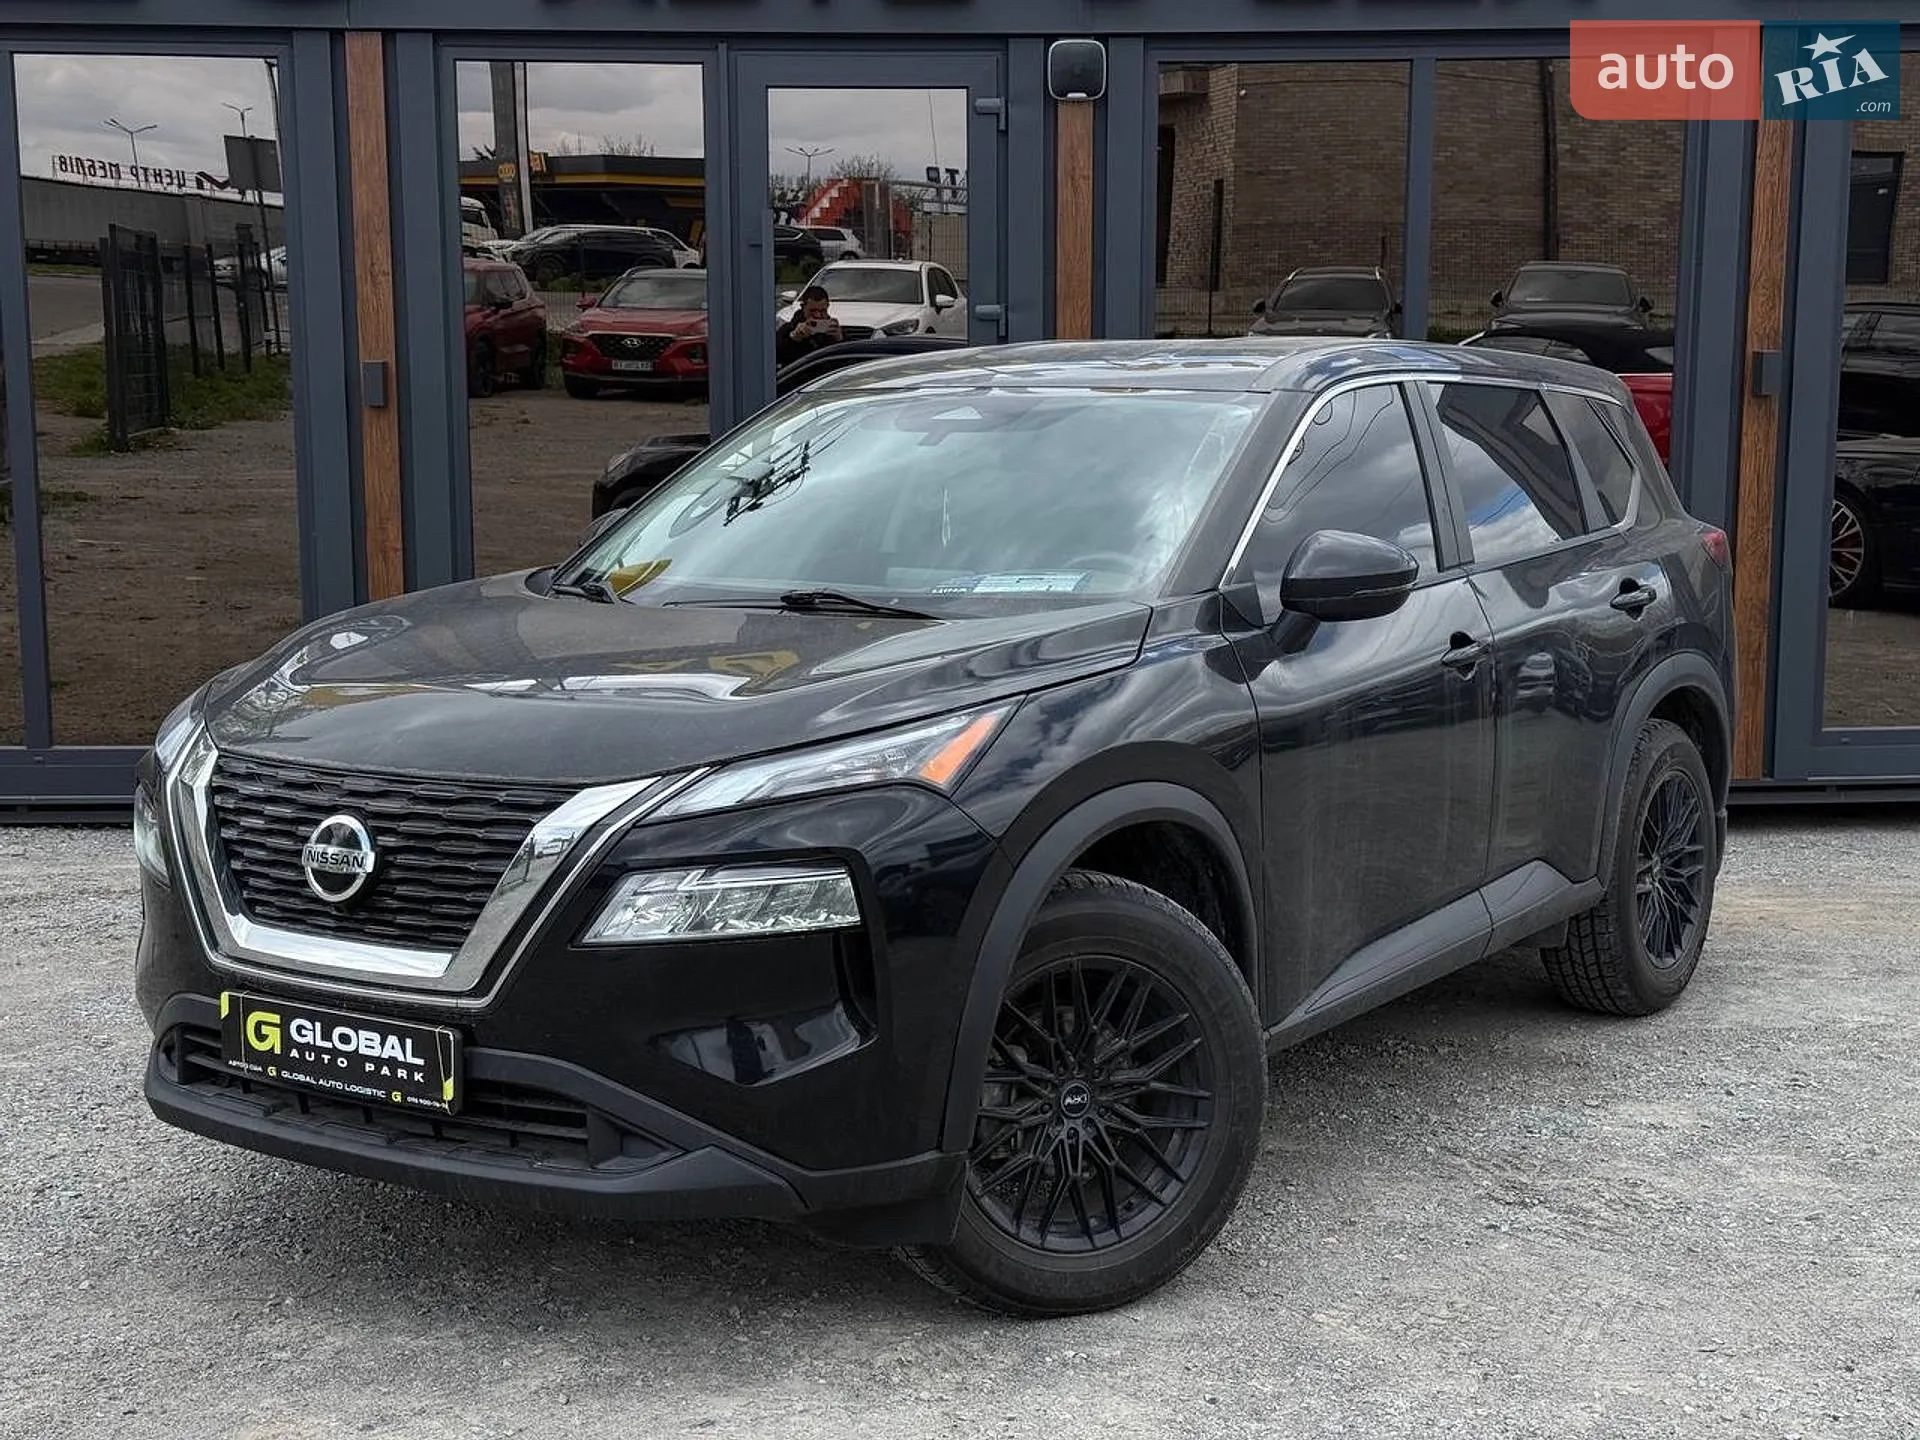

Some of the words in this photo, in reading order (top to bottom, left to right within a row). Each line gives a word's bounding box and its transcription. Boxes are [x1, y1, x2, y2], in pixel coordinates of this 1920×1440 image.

[306, 849, 364, 868] NISSAN
[290, 1018, 425, 1066] GLOBAL
[290, 1049, 347, 1068] AUTO
[365, 1063, 424, 1083] PARK
[281, 1070, 317, 1085] GLOBAL
[318, 1078, 343, 1090] AUTO
[344, 1084, 387, 1098] LOGISTIC
